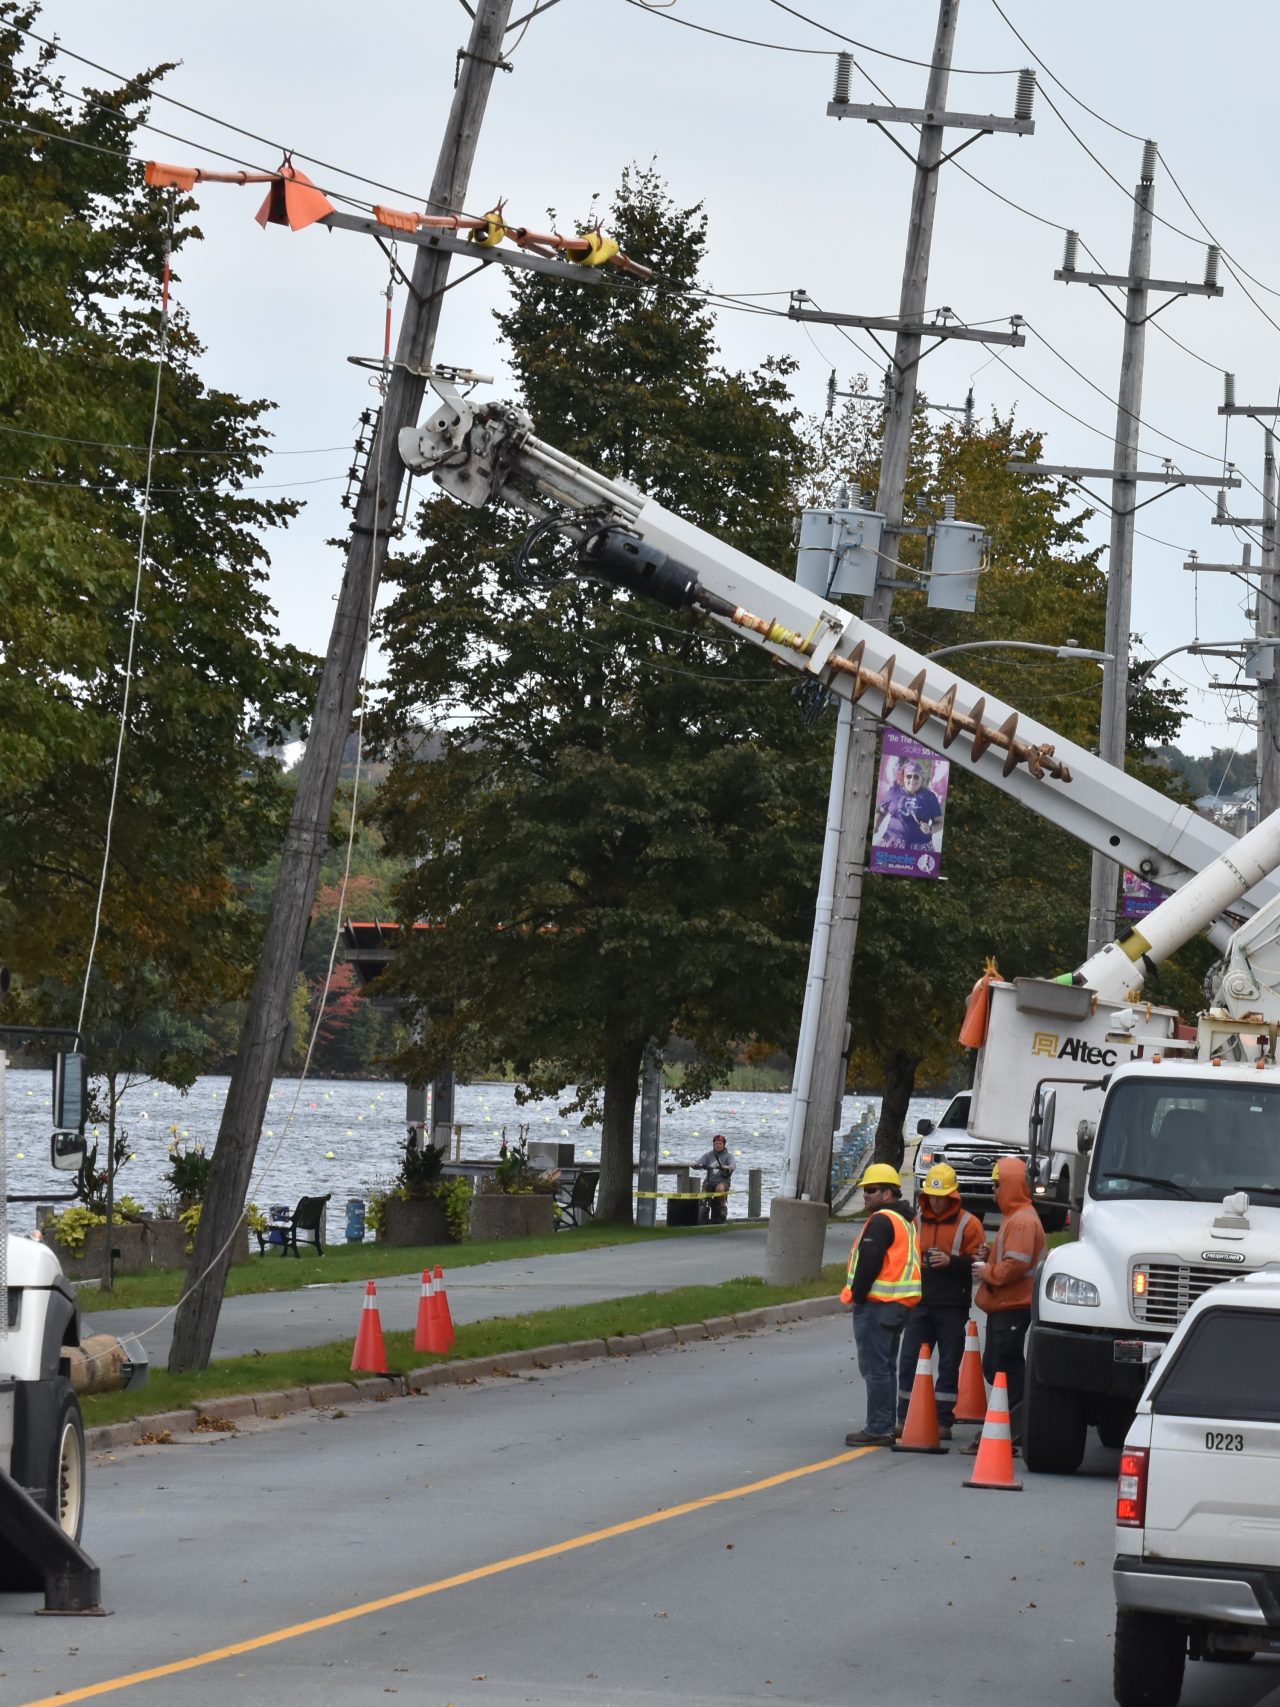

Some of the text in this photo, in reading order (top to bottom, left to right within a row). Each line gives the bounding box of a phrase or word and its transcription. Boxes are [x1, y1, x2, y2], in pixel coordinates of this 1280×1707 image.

[1057, 1037, 1118, 1067] Altec
[1206, 1253, 1240, 1261] FREIGHTLINER
[1205, 1432, 1244, 1452] 0223
